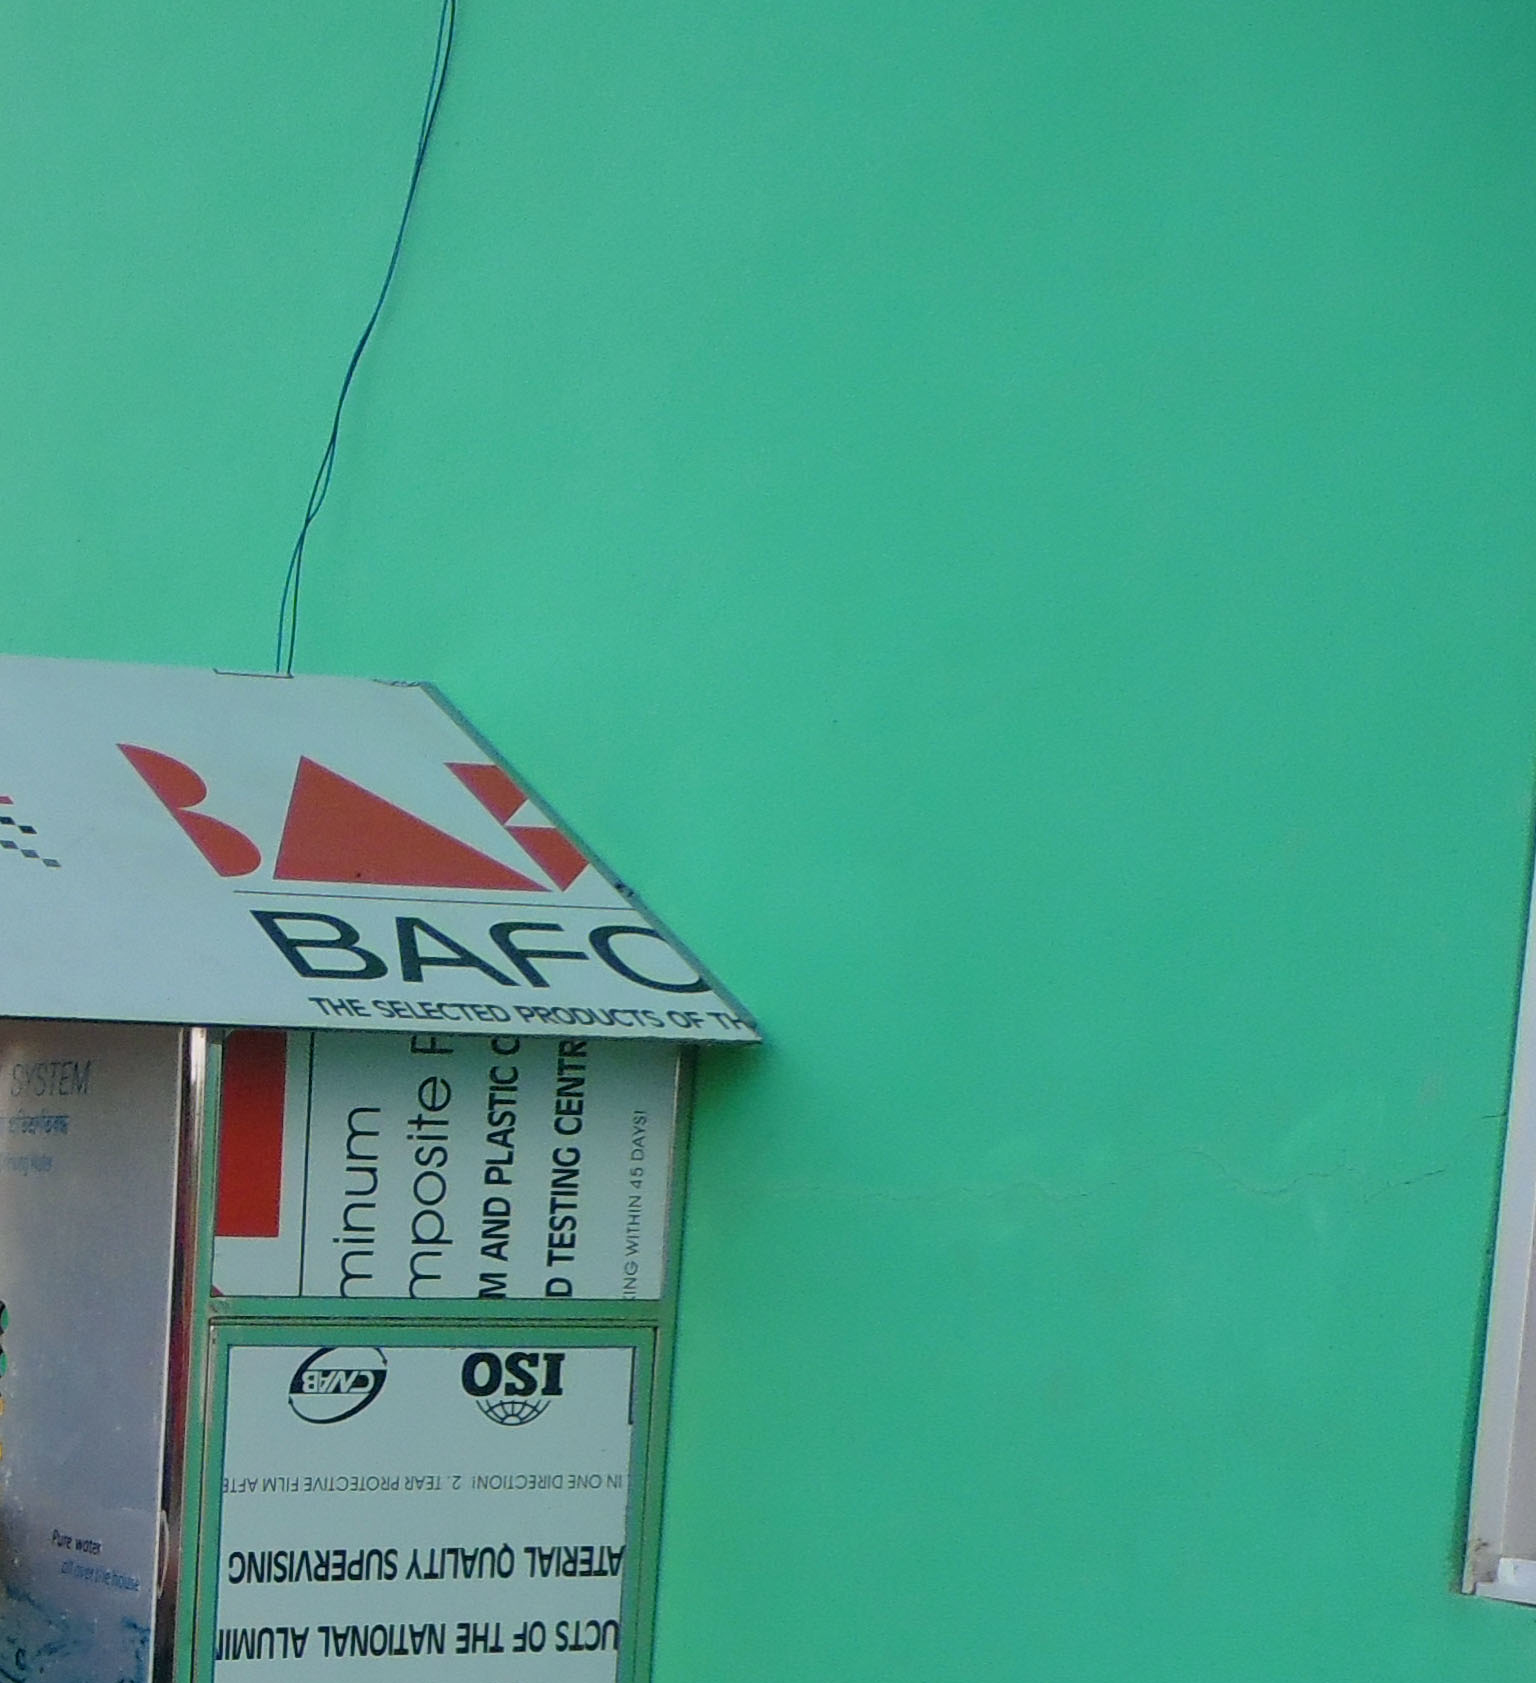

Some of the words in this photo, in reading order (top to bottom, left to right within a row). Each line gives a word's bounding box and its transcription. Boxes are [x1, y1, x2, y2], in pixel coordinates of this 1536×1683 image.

[309, 996, 371, 1018] THE
[373, 998, 512, 1024] SELECTED
[514, 1004, 665, 1030] PRODUCTS
[667, 1008, 704, 1030] OF
[483, 1065, 520, 1186] PLASTIC
[630, 1110, 648, 1161] DAYS!
[632, 1167, 644, 1190] 45
[546, 1147, 581, 1268] TESTING
[480, 1196, 511, 1262] AND
[625, 1195, 643, 1257] WITHIN
[544, 1277, 573, 1298] D
[622, 1261, 640, 1299] ING
[461, 1351, 566, 1397] ISO
[261, 1477, 299, 1494] FILM
[302, 1476, 401, 1493] PROTECTIVE
[402, 1476, 442, 1492] TEAR
[446, 1475, 464, 1492] 2.
[471, 1475, 564, 1492] DIRECTION!
[568, 1474, 603, 1490] ONE
[606, 1474, 624, 1490] IN
[228, 1548, 399, 1585] SUPERVISING
[405, 1542, 515, 1581] QUALITY
[522, 1544, 627, 1579] ATERIAL
[317, 1622, 446, 1658] NATIONAL
[455, 1622, 505, 1655] THE
[511, 1620, 547, 1653] OF
